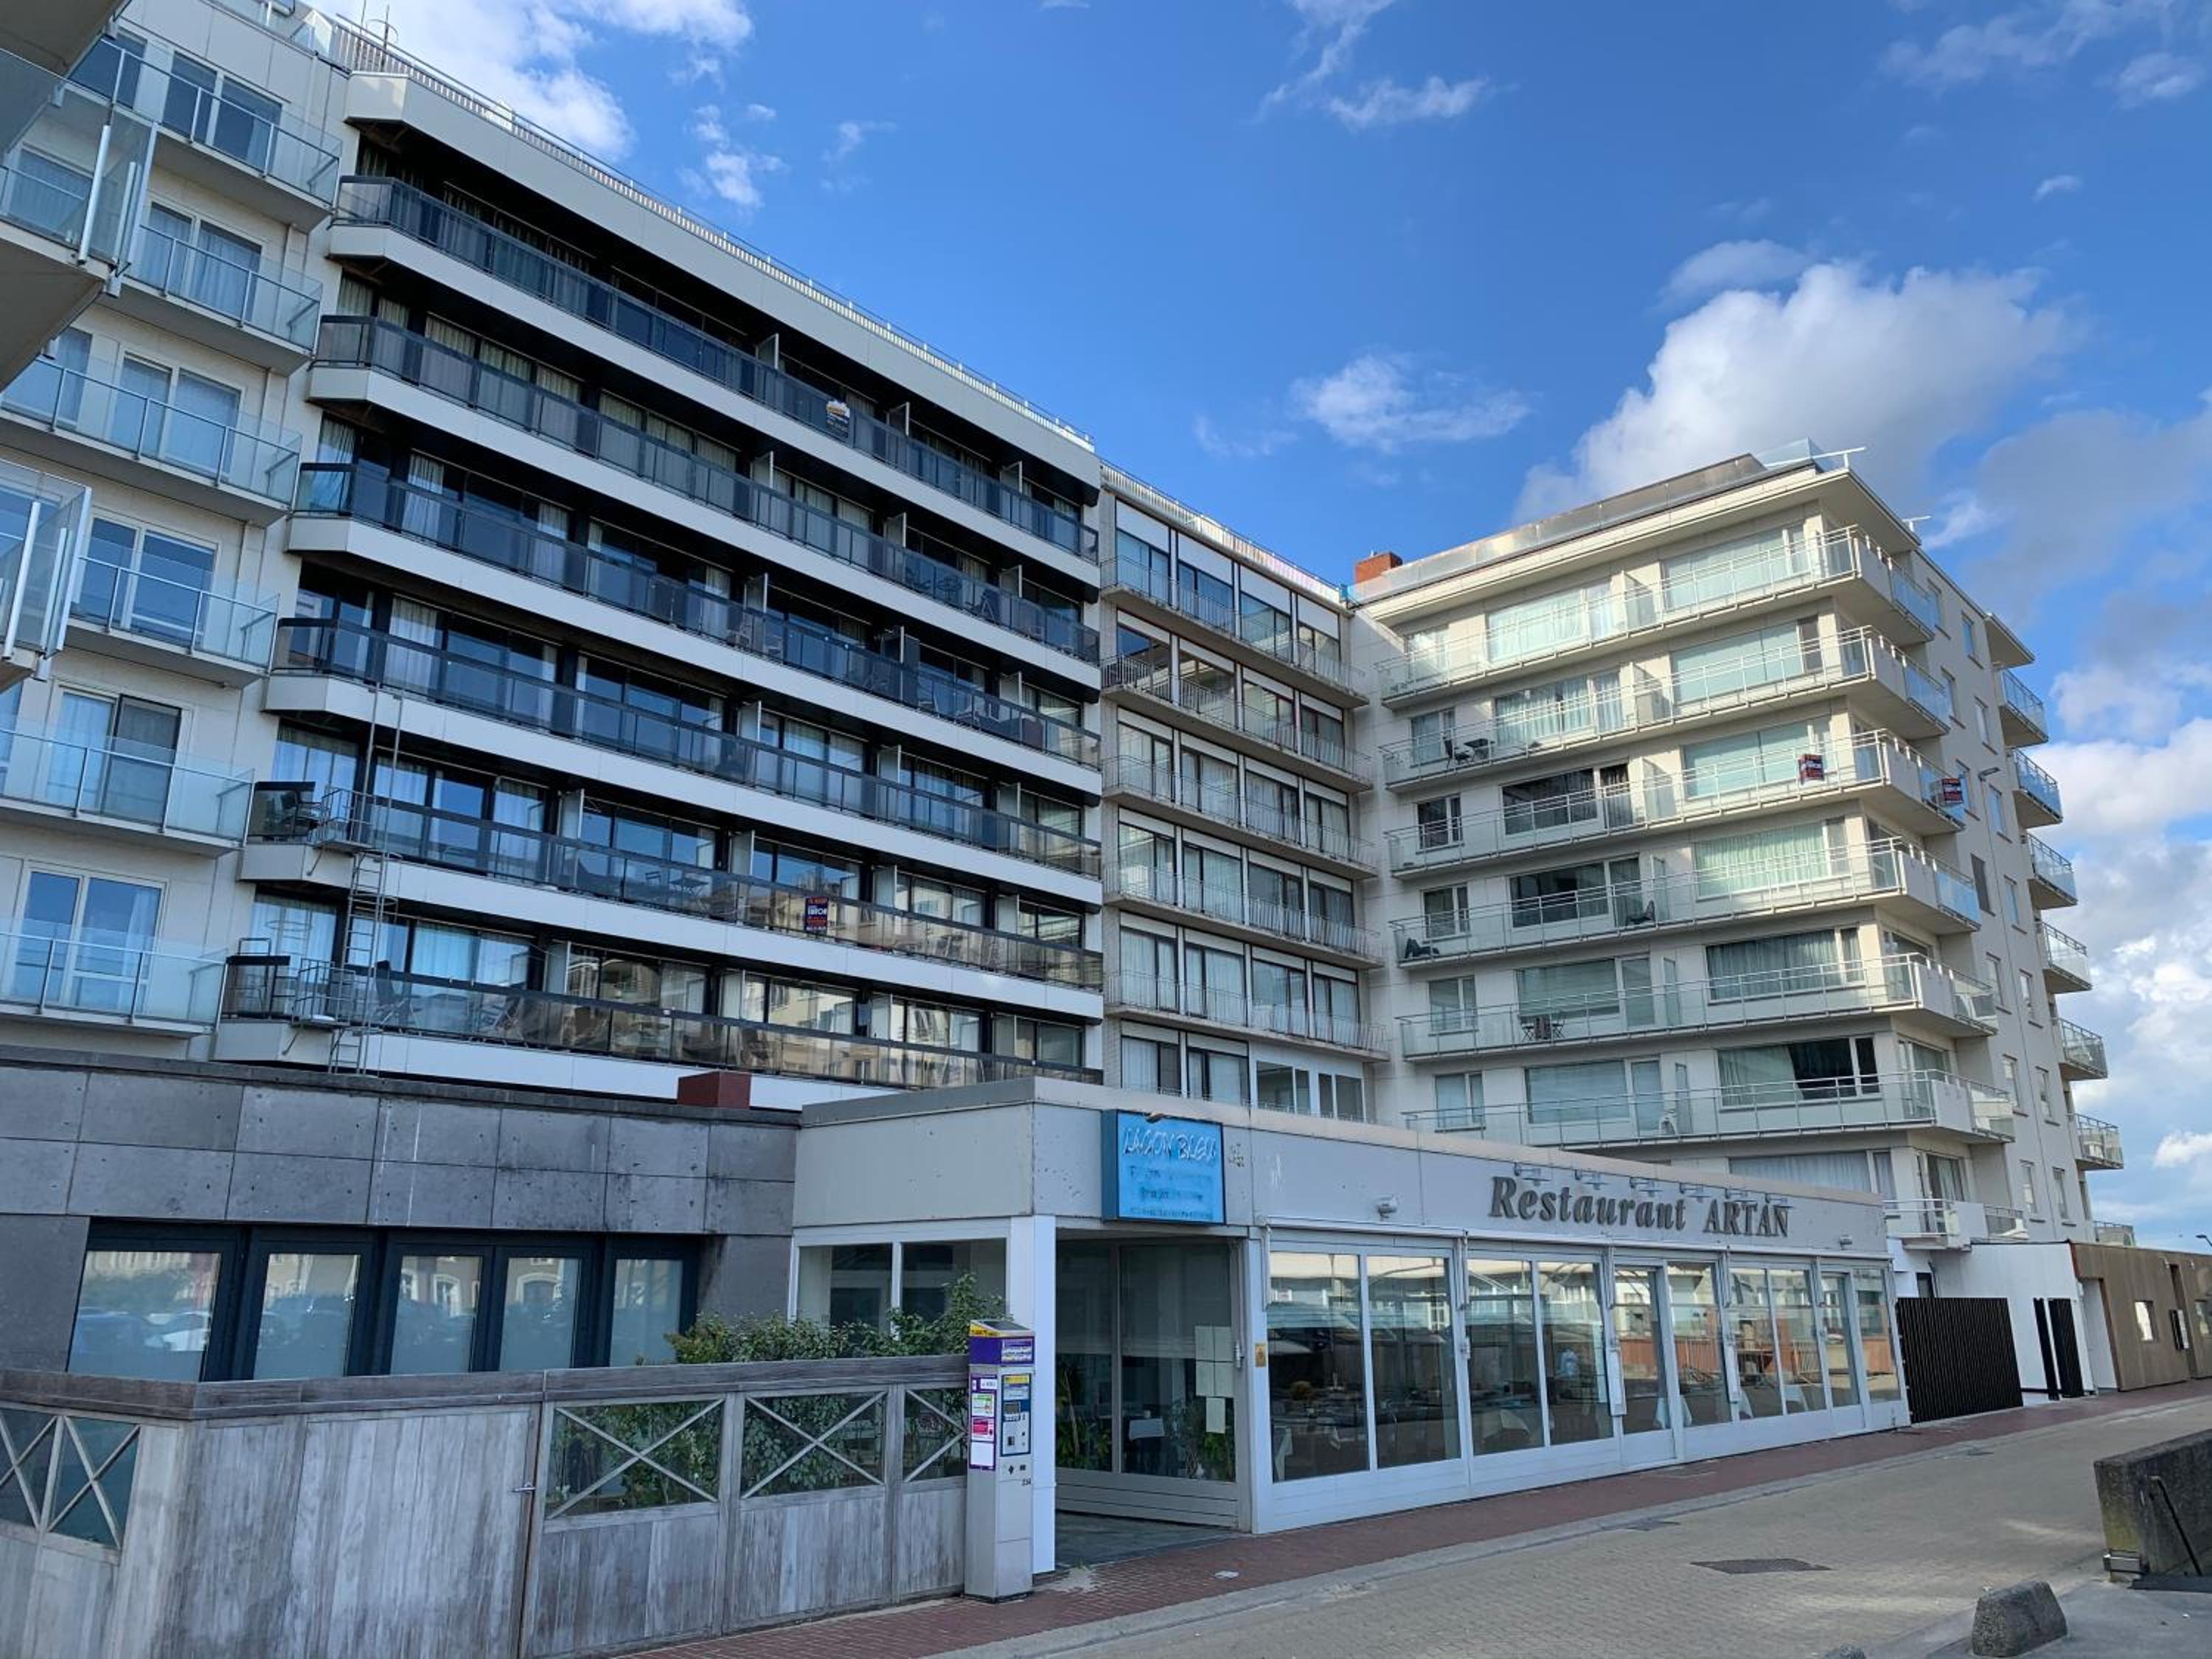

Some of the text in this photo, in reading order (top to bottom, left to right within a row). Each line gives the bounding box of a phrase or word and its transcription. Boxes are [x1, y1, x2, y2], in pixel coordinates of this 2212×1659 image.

[1177, 1134, 1216, 1161] BLEU
[1489, 1176, 1789, 1237] Restaurant ARTAN
